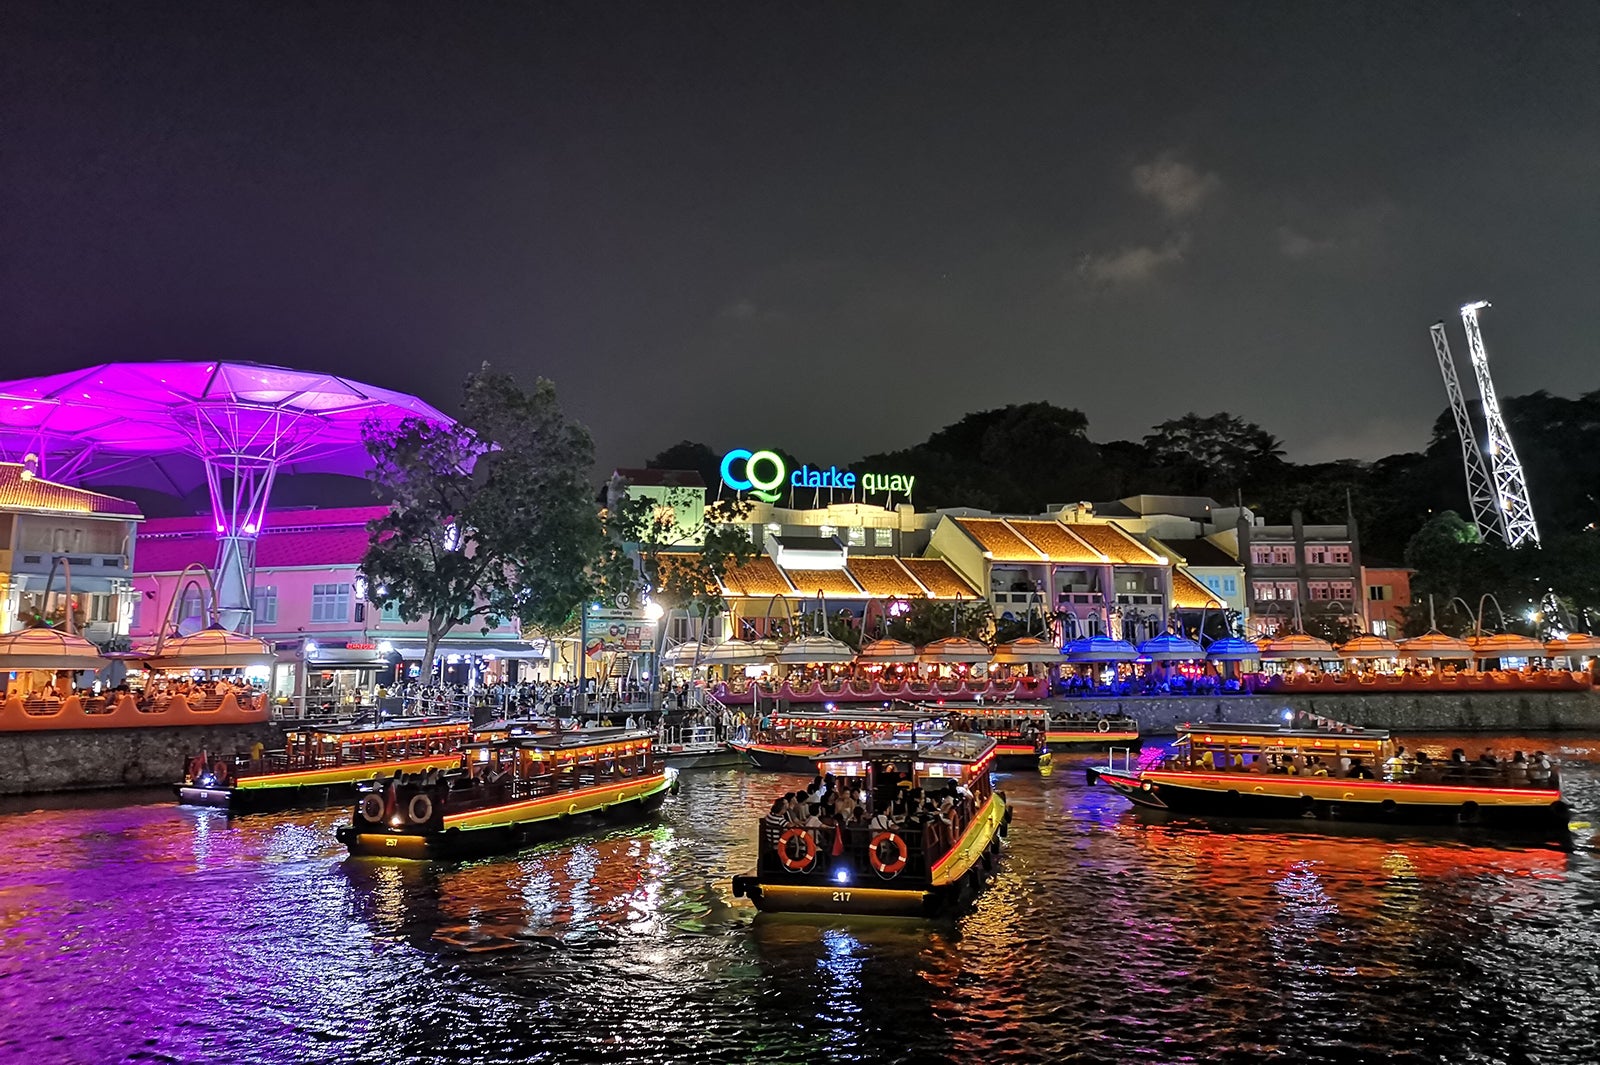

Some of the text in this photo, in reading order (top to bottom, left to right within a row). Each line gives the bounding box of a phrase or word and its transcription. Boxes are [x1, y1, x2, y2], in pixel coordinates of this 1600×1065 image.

[720, 449, 915, 502] CQ clarke quay
[385, 838, 398, 846] 257
[832, 891, 851, 902] 217
